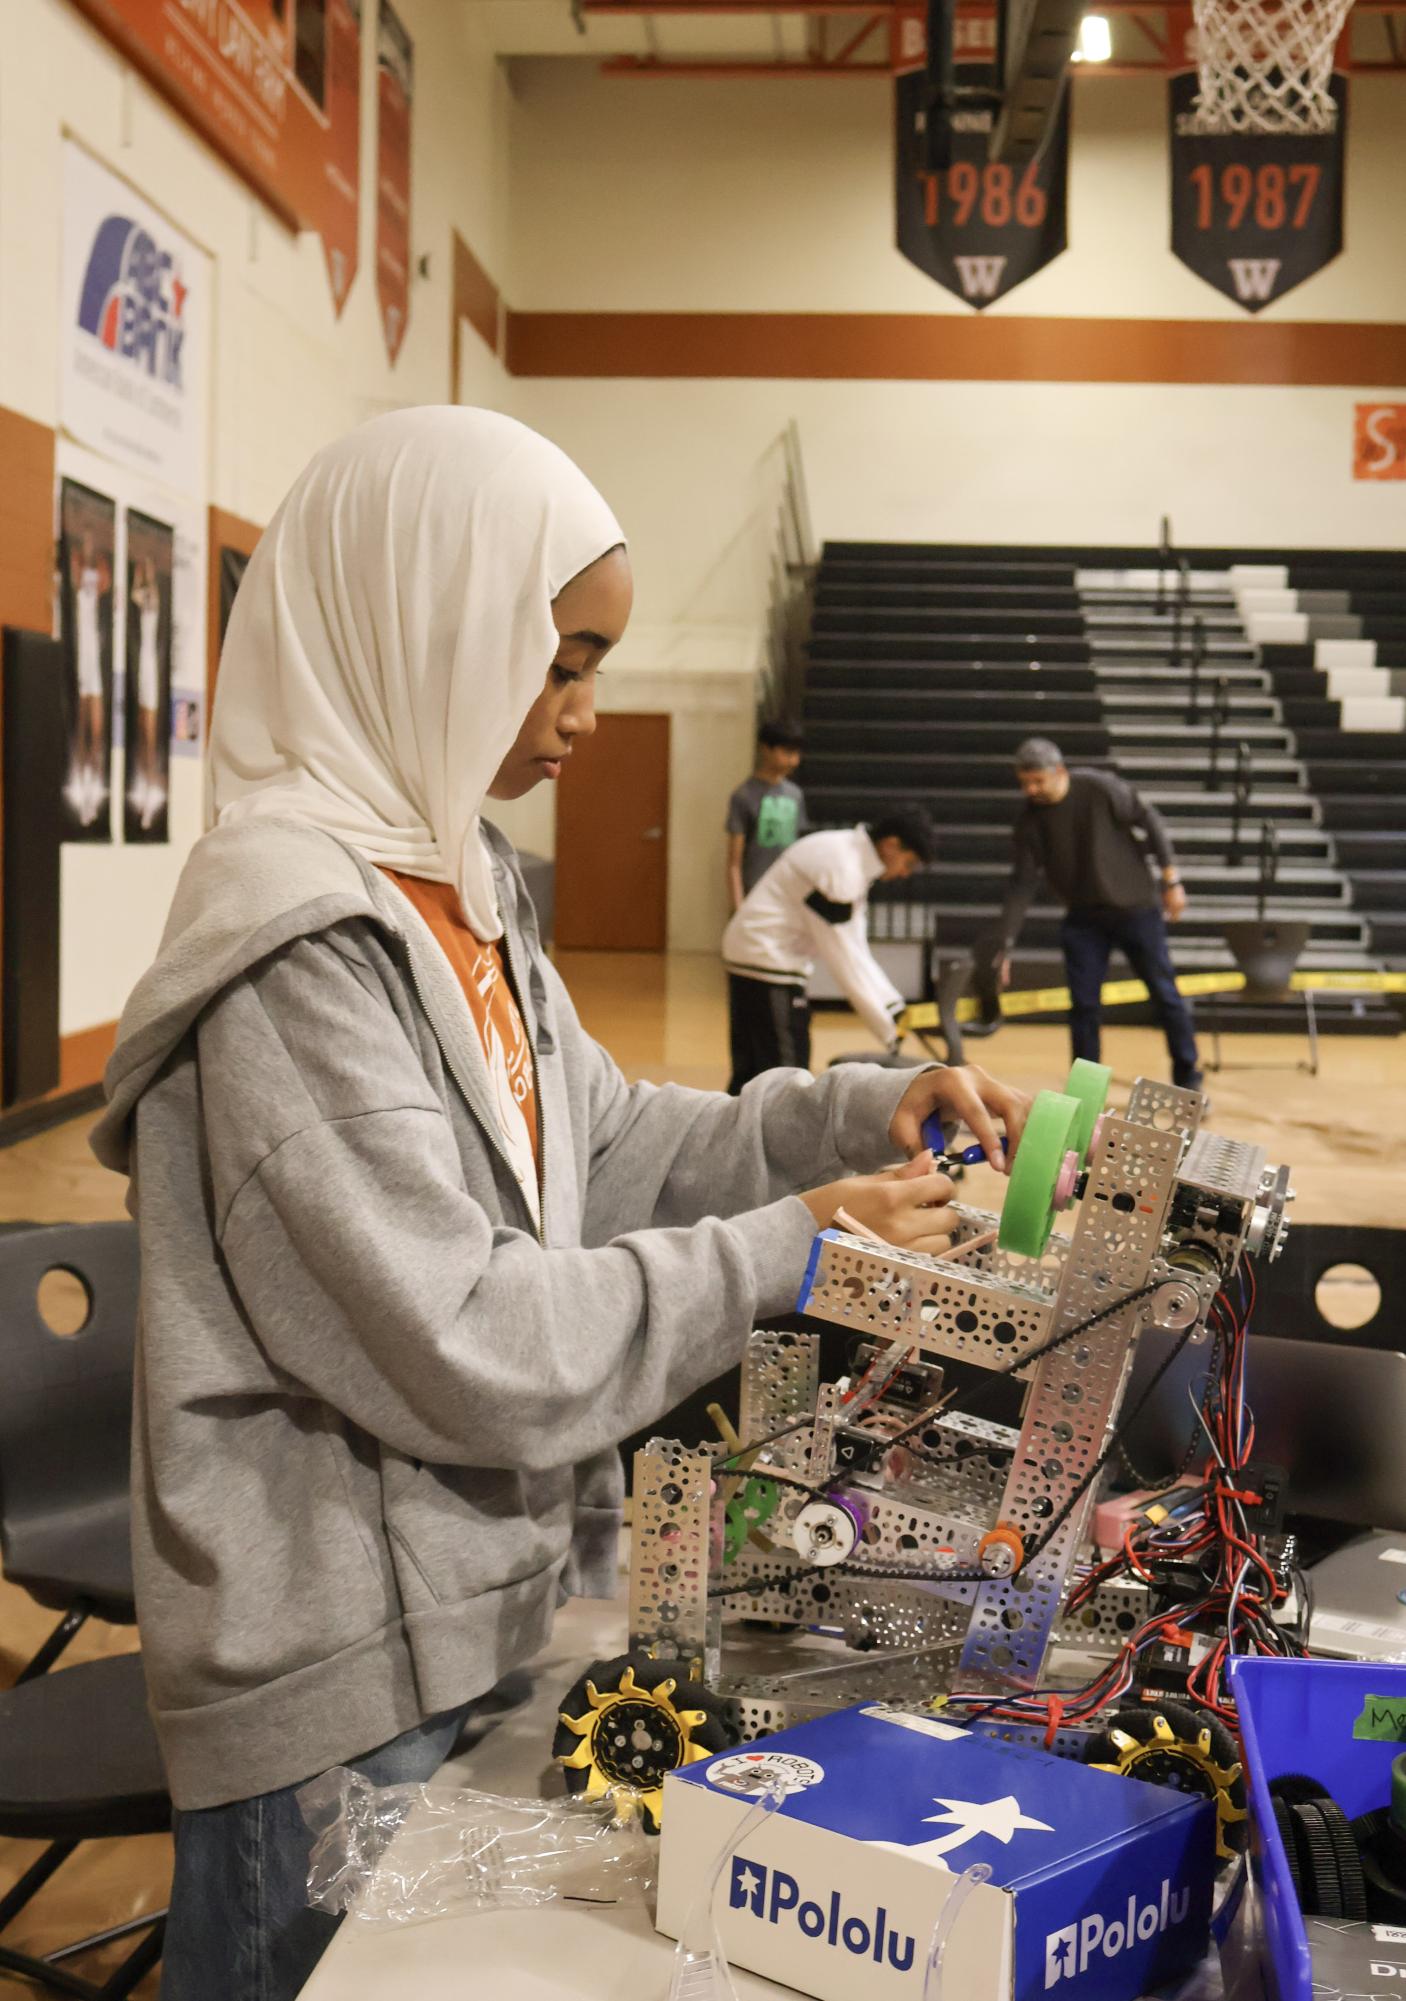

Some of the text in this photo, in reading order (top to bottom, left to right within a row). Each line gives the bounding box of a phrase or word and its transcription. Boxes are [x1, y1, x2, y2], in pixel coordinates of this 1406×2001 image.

[918, 162, 1047, 227] 1986
[1191, 163, 1322, 230] 1987
[954, 255, 1007, 298] W
[1228, 258, 1282, 301] W
[769, 1864, 916, 1972] Pololu
[1079, 1878, 1191, 1974] Pololu
